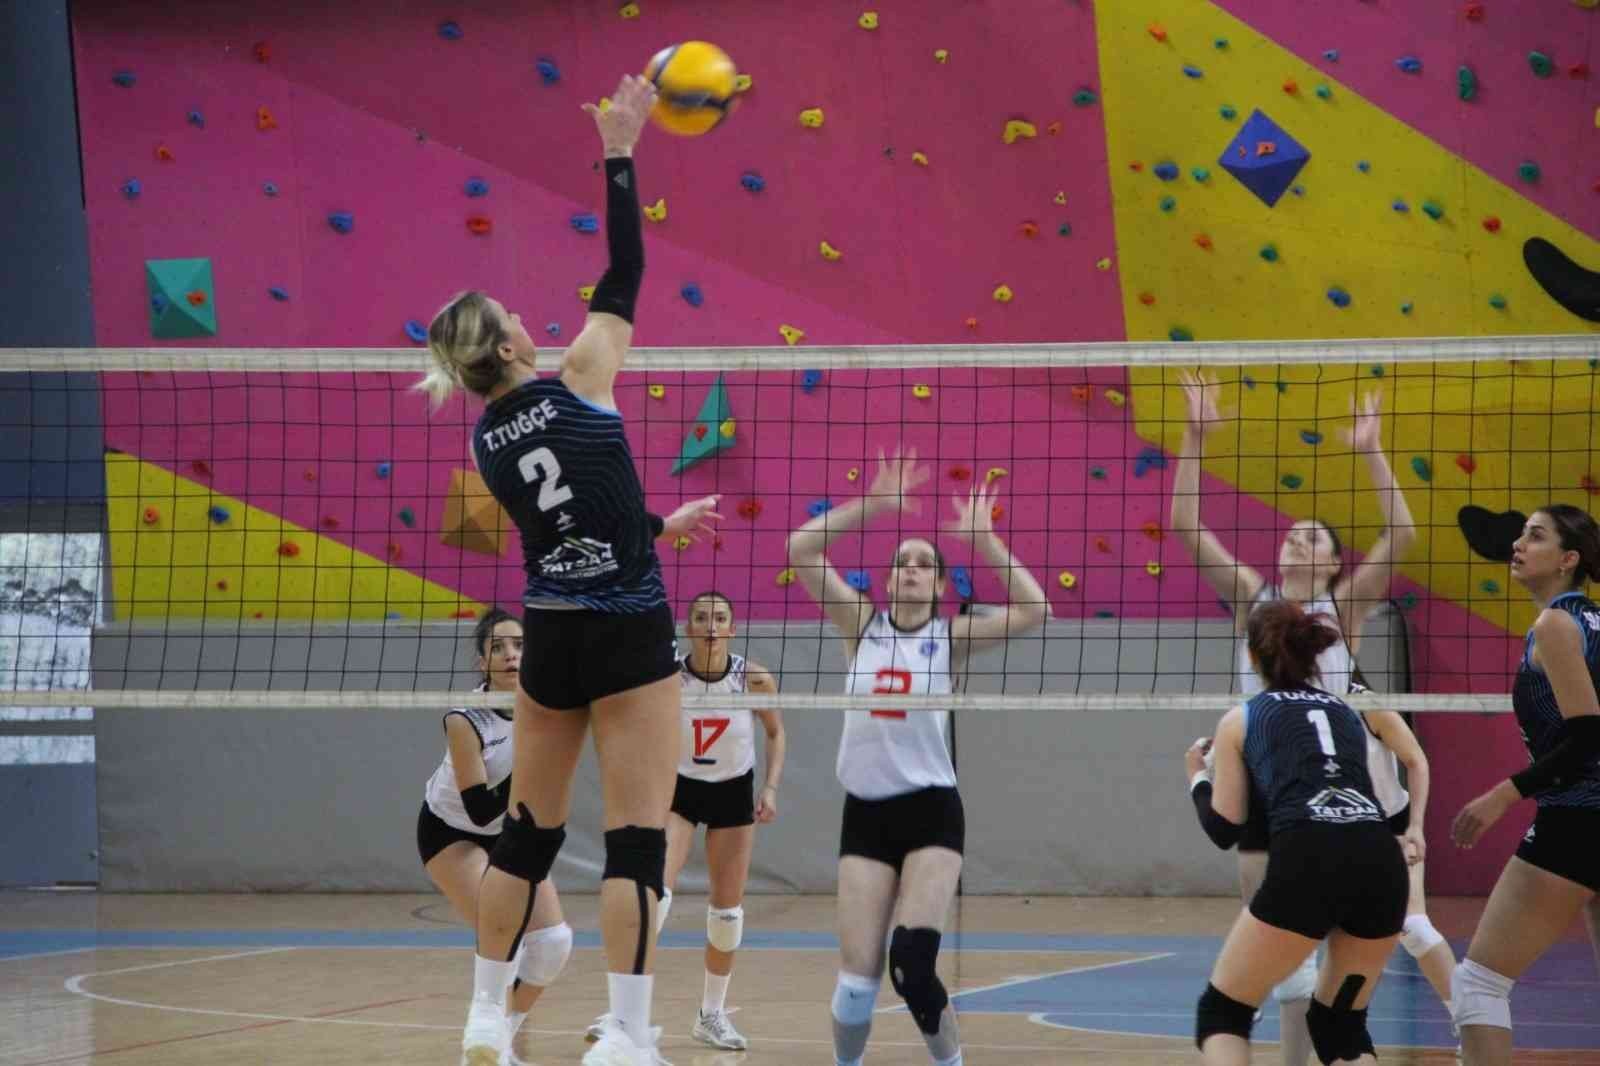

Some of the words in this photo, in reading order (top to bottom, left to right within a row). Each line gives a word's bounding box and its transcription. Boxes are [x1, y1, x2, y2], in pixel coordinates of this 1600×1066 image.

[482, 398, 559, 452] T.TUĞÇE
[517, 446, 575, 513] 2
[869, 667, 912, 720] 2
[691, 718, 731, 758] 17
[1306, 709, 1337, 757] 1
